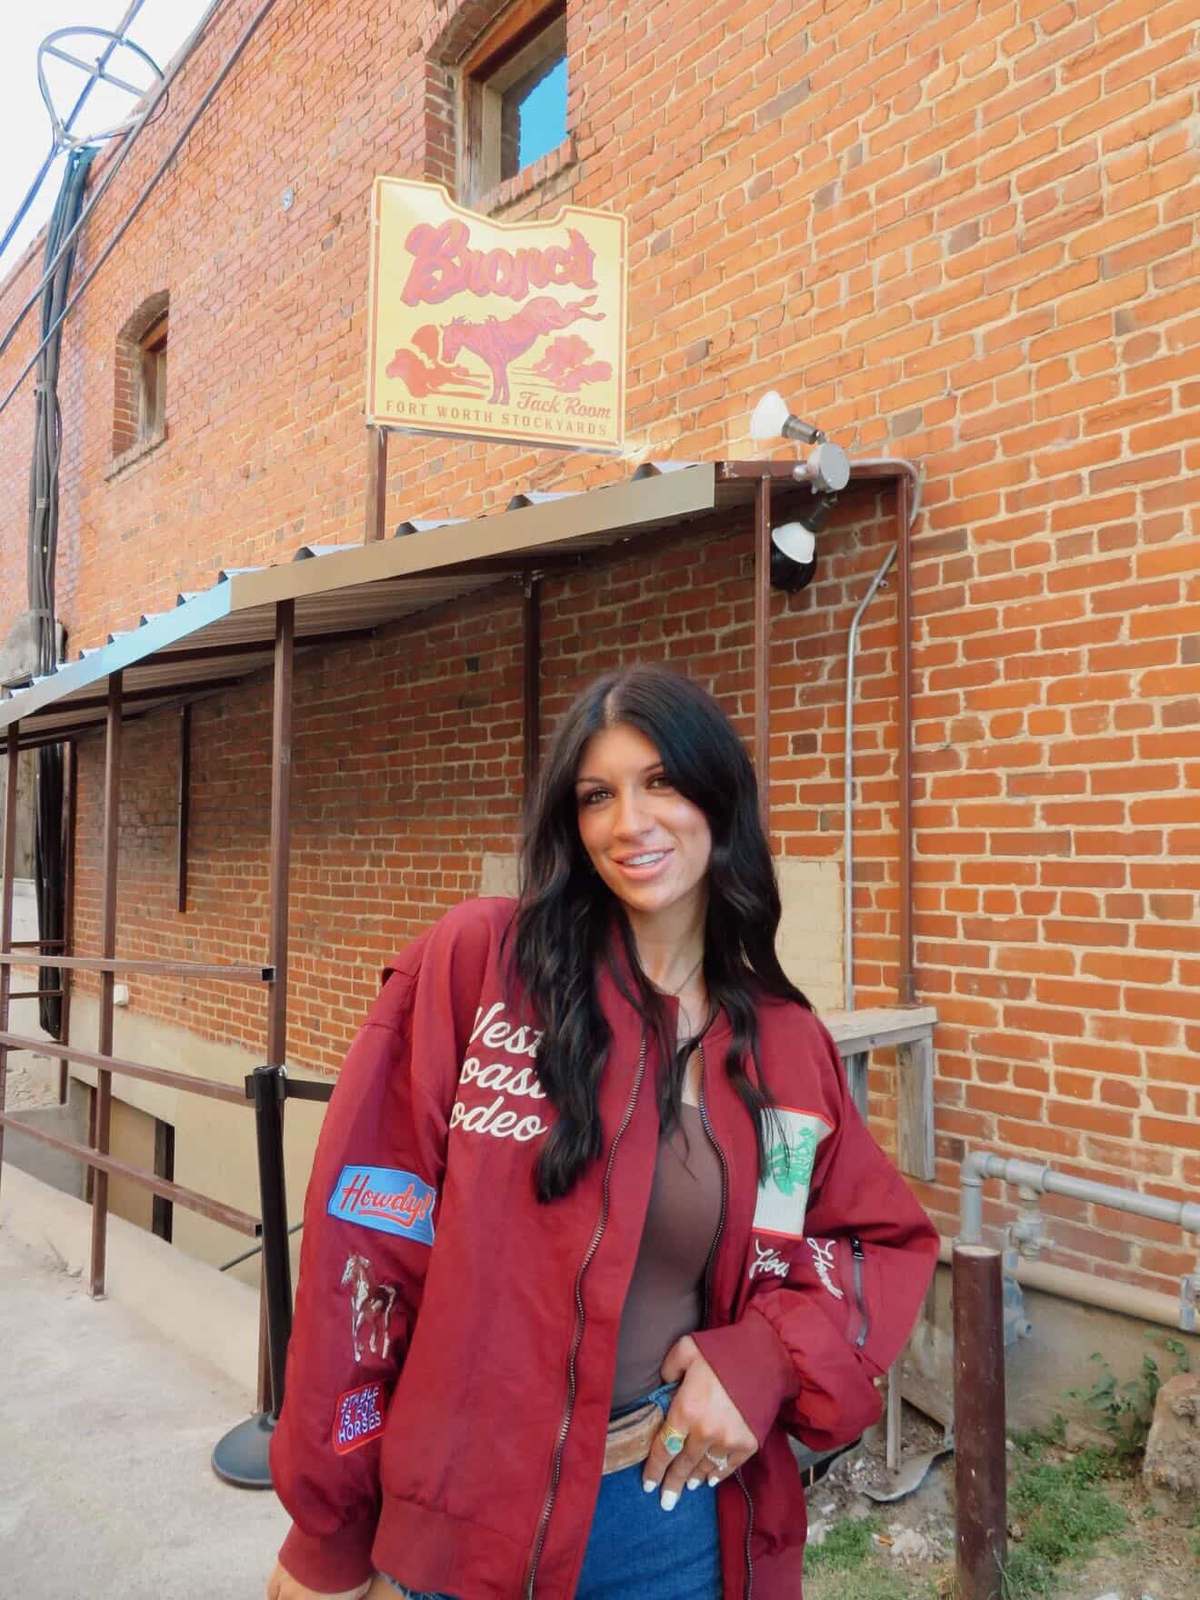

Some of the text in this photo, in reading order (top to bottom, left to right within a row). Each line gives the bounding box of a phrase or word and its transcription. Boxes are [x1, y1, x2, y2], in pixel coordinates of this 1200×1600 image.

[386, 400, 608, 436] FORT WORTH STOCKYARDS
[516, 391, 611, 420] Tack Room
[450, 1096, 548, 1142] odeo
[340, 1173, 433, 1229] Howdy!
[338, 1411, 382, 1444] HORSES
